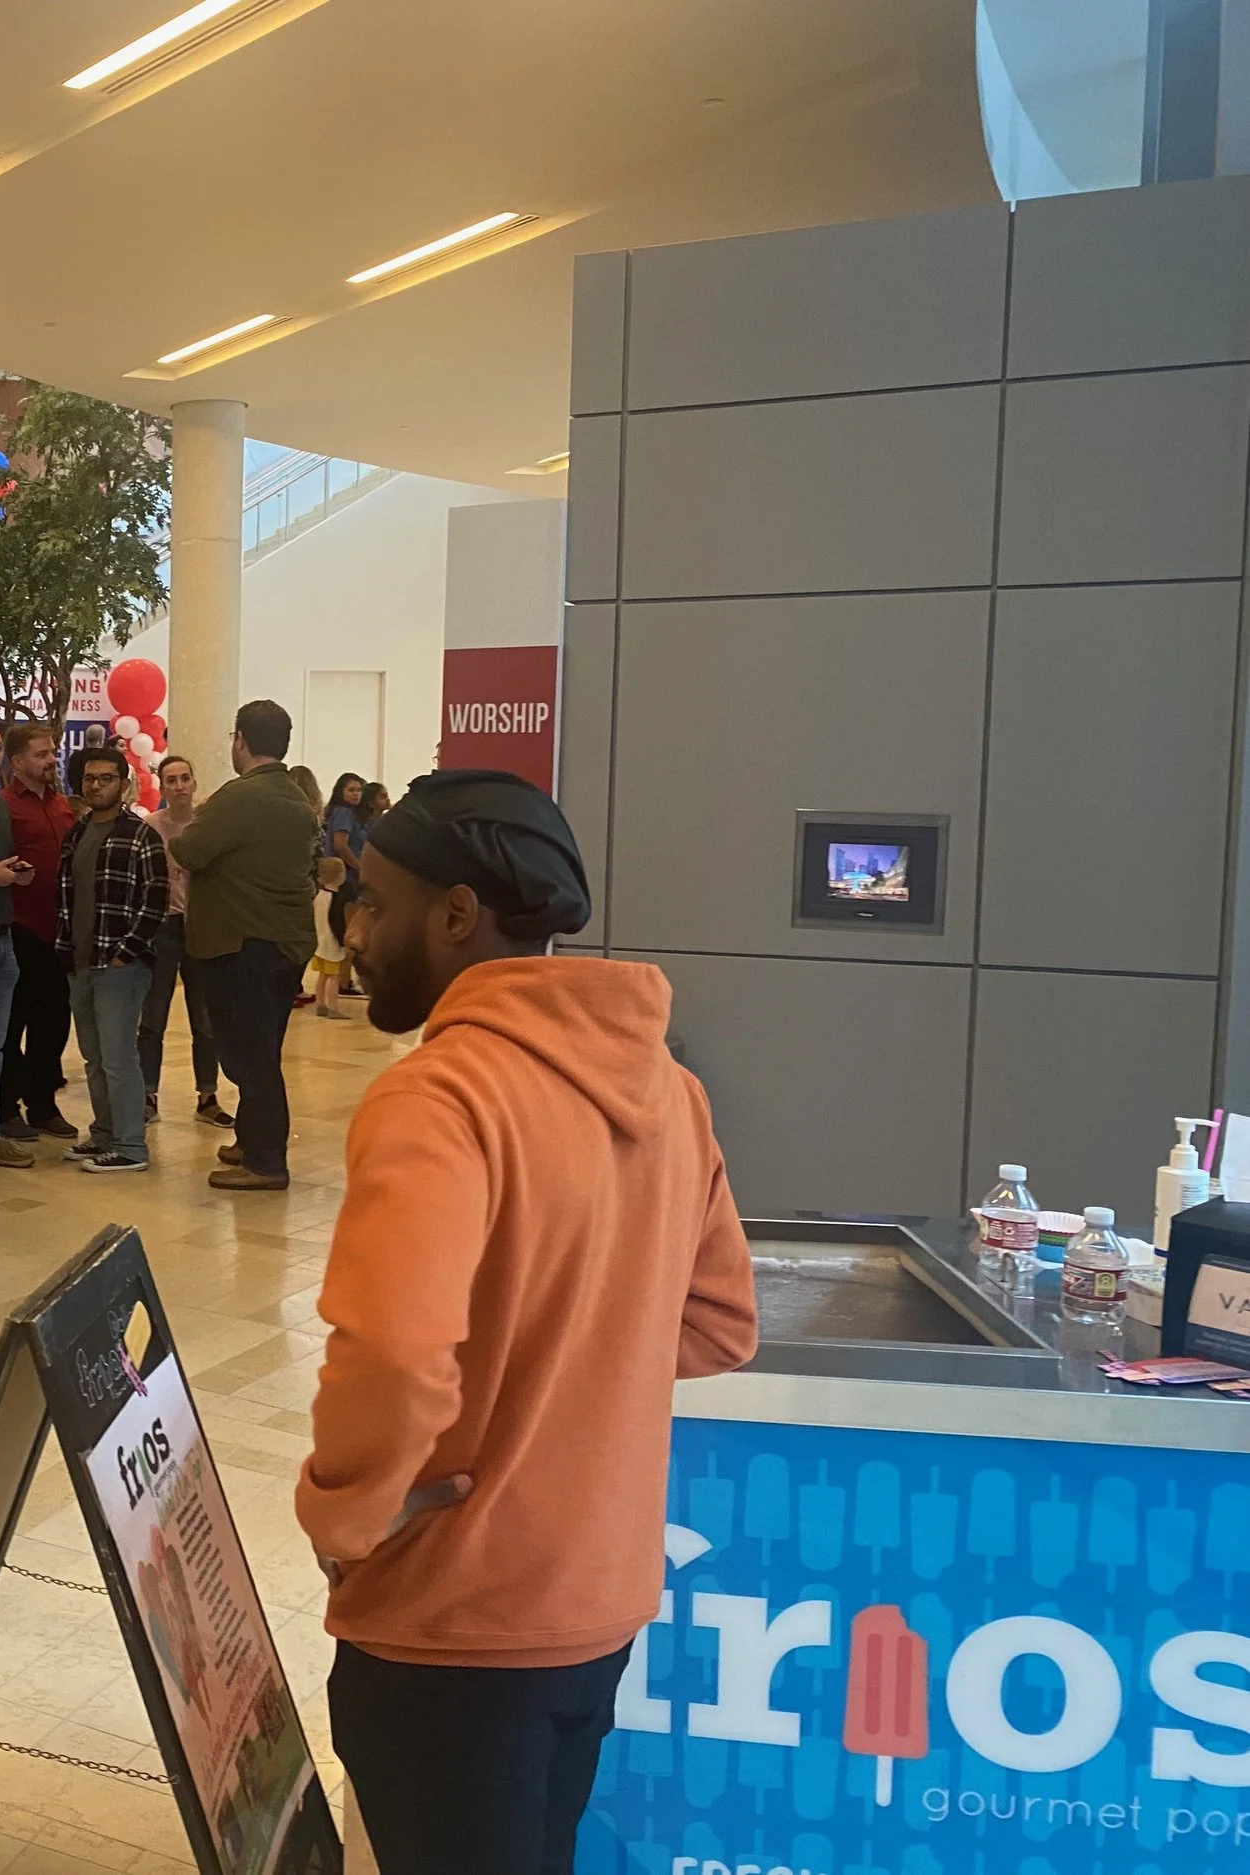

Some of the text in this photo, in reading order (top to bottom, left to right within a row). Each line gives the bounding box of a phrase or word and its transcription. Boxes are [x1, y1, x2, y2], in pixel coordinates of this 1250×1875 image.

[72, 700, 101, 712] NESS
[448, 702, 549, 733] WORSHIP
[922, 1787, 1142, 1830] gourmet
